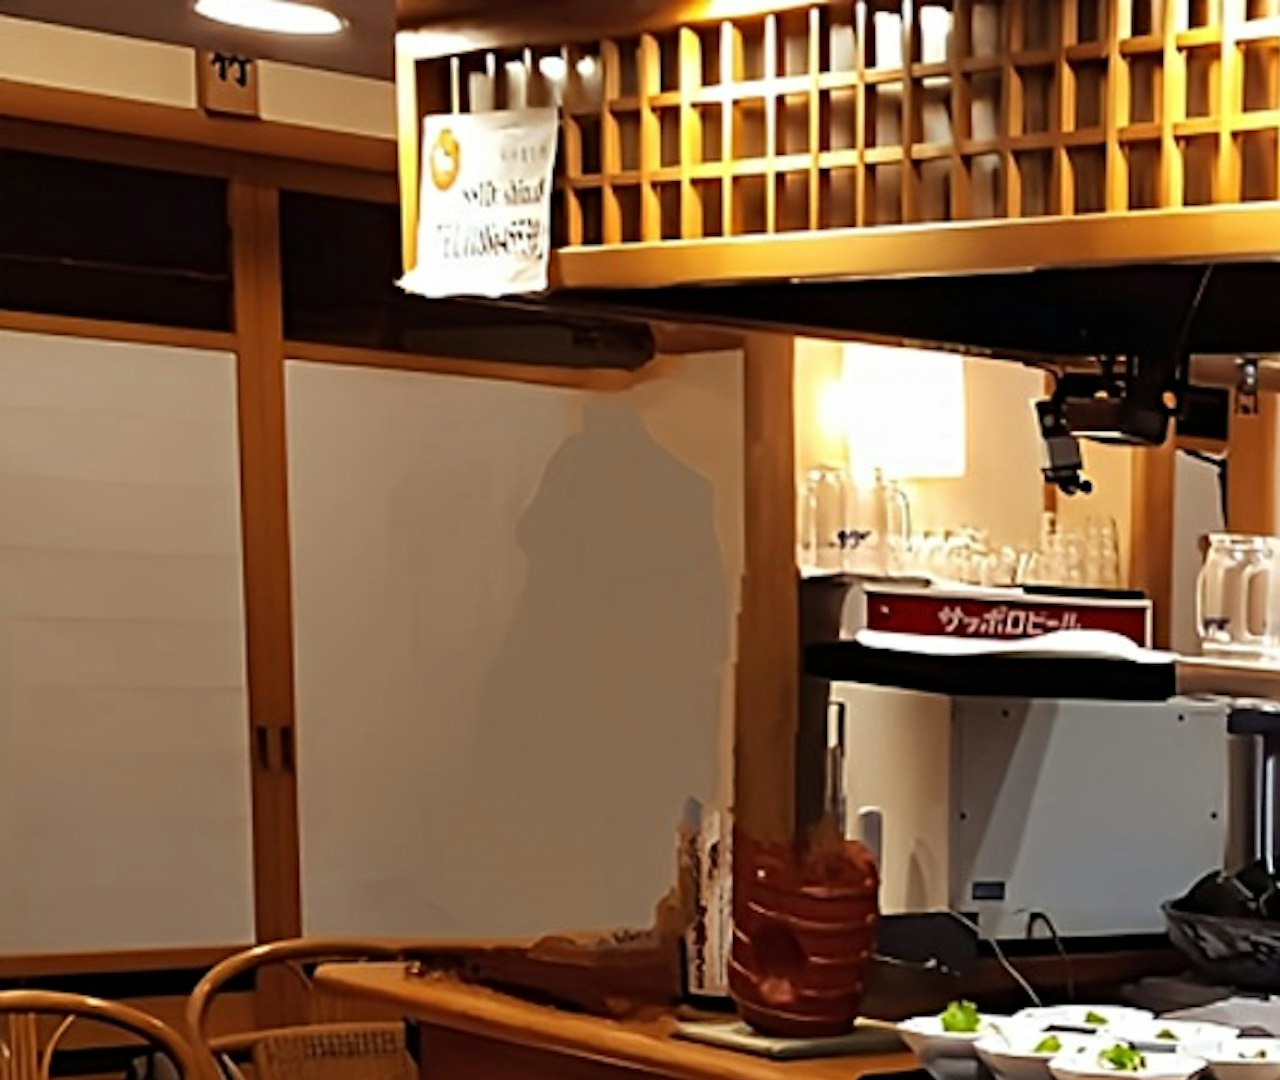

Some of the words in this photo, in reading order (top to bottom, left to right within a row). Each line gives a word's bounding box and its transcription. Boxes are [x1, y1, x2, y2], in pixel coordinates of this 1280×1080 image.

[937, 604, 1082, 635] サッポロビール
